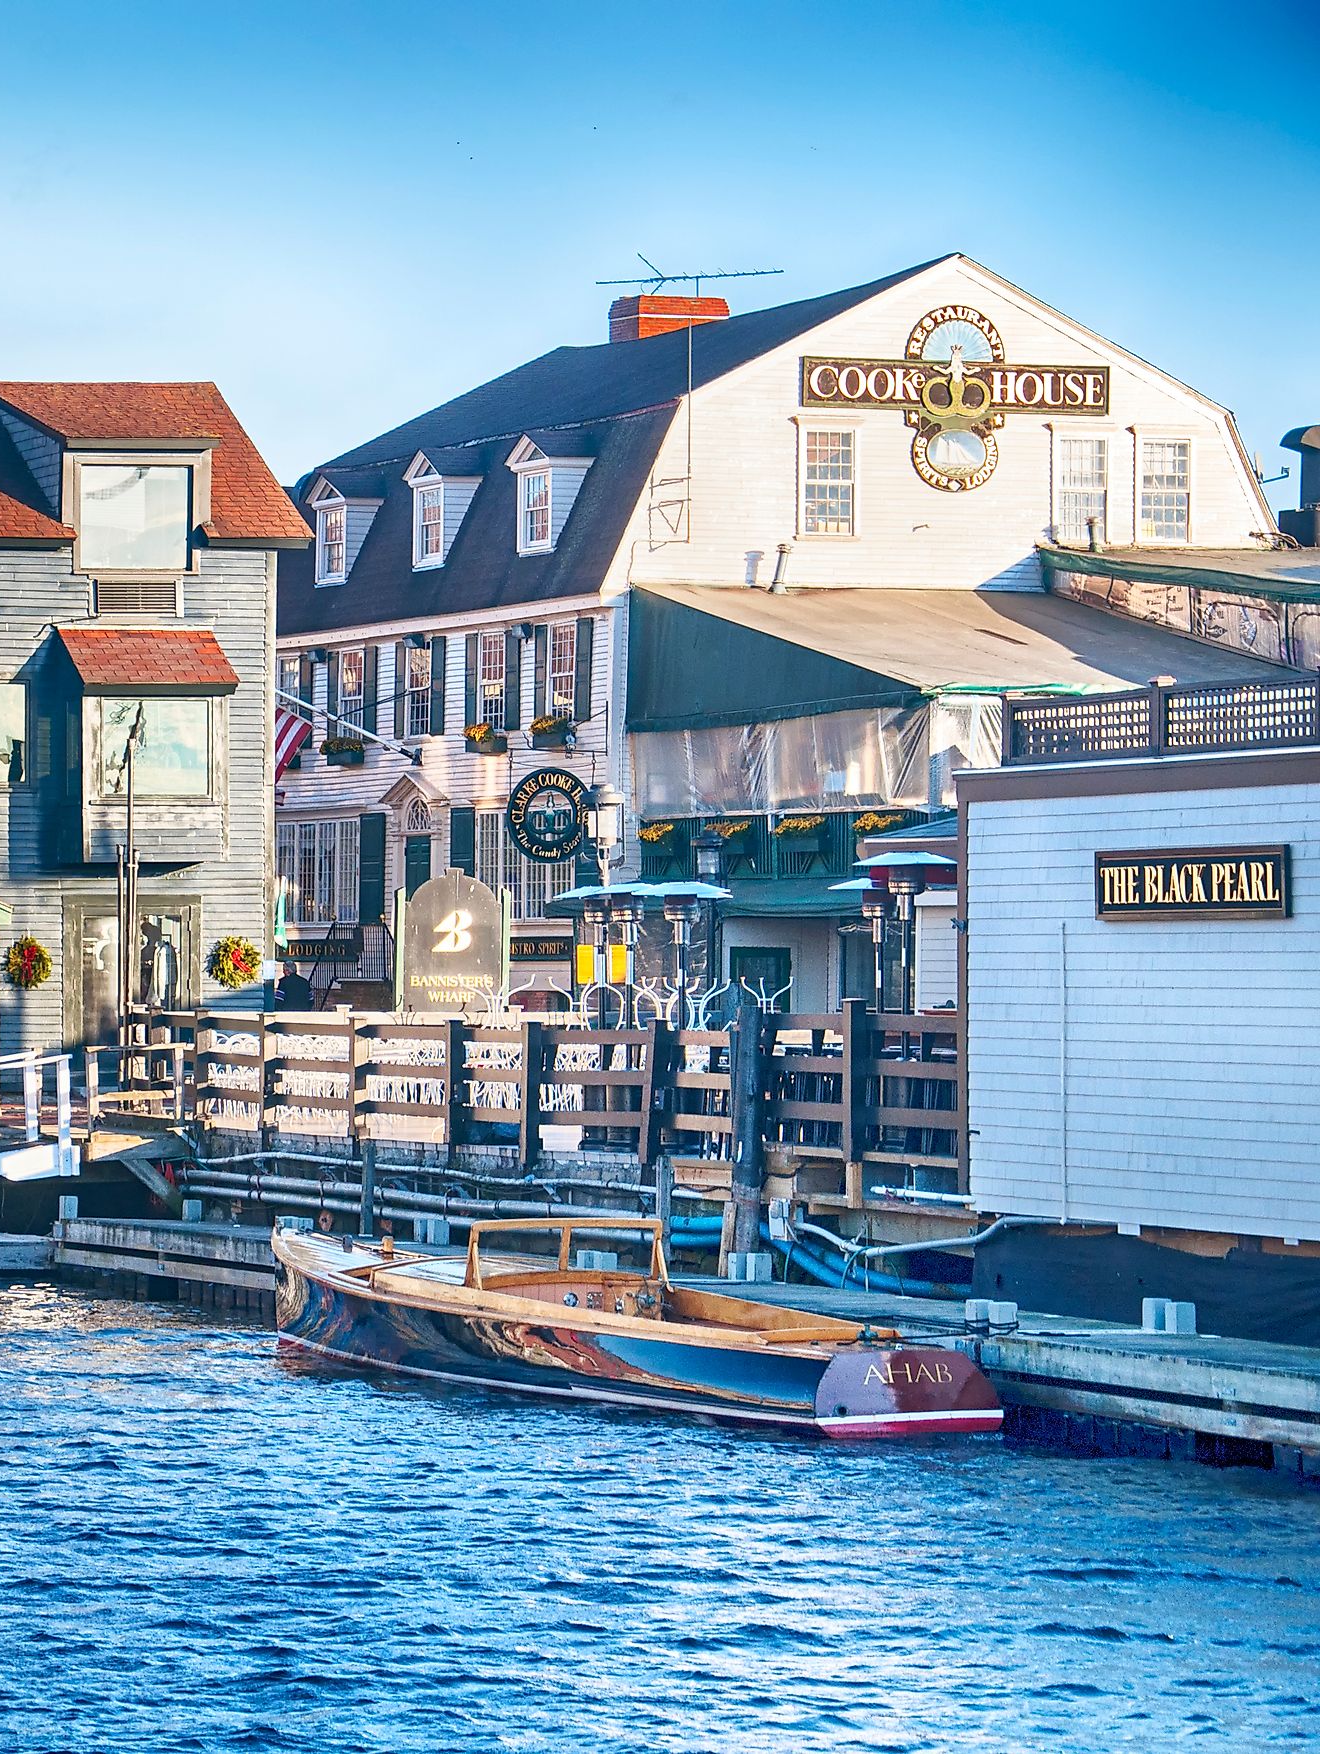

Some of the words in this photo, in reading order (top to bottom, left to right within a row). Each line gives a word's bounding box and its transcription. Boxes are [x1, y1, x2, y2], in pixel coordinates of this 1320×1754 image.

[909, 306, 1004, 359] RESTAURANT
[991, 371, 1105, 407] HOUSE
[914, 436, 949, 486] SPIRITS
[965, 434, 997, 489] LODGING
[512, 778, 539, 823] CLARKE
[538, 773, 575, 793] COOKE
[516, 829, 531, 849] The
[532, 845, 561, 859] Candy
[1100, 866, 1139, 905] THE
[1143, 863, 1208, 904] BLACK
[1211, 861, 1280, 902] PEARL
[288, 944, 345, 956] LODGING
[510, 942, 535, 955] ISTRO
[428, 991, 476, 1003] WHARF
[864, 1362, 953, 1385] AHAB
